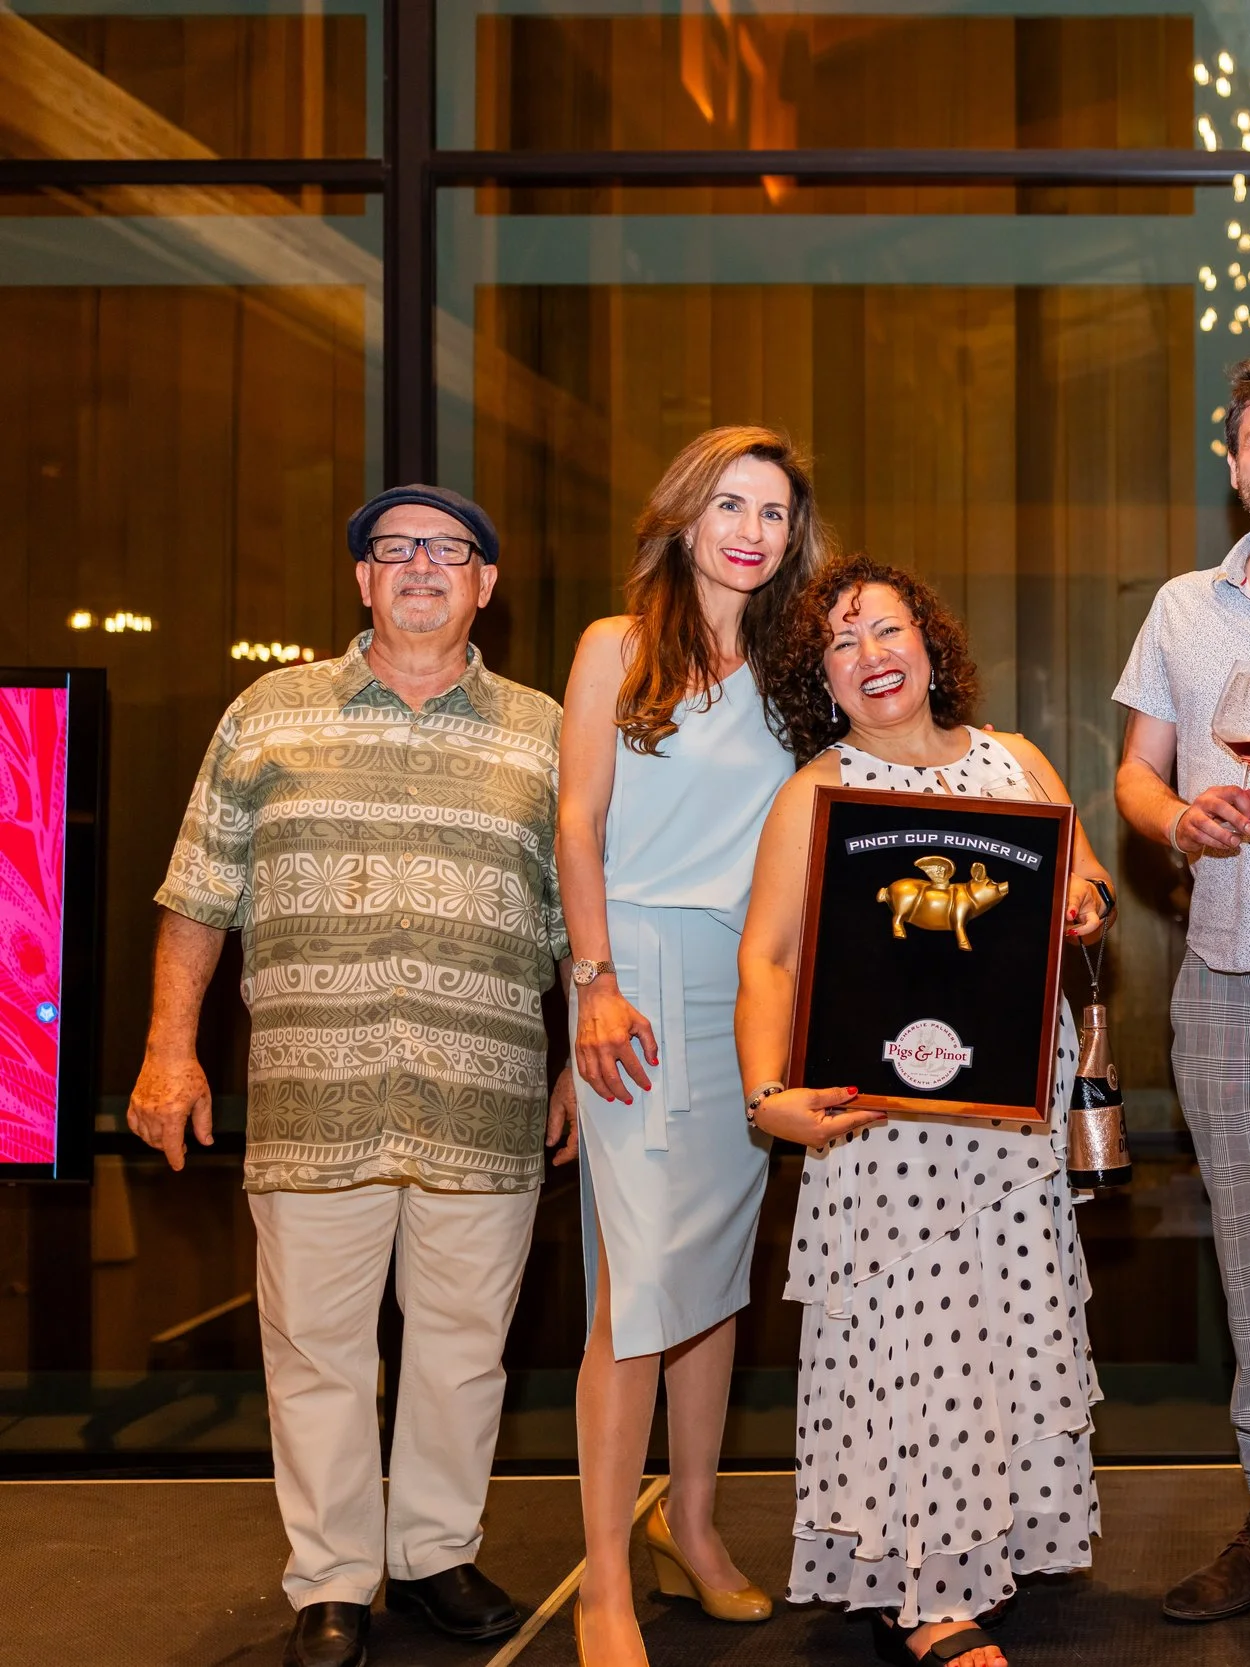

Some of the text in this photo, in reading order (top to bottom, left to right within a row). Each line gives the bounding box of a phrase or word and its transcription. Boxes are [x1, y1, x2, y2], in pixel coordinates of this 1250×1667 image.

[849, 834, 1038, 865] PINOT CUP RUNNER UP
[900, 1022, 958, 1049] CHARLIE PALMER'S
[888, 1043, 968, 1062] Pigs & Pinot
[933, 1066, 955, 1084] ANNUAL
